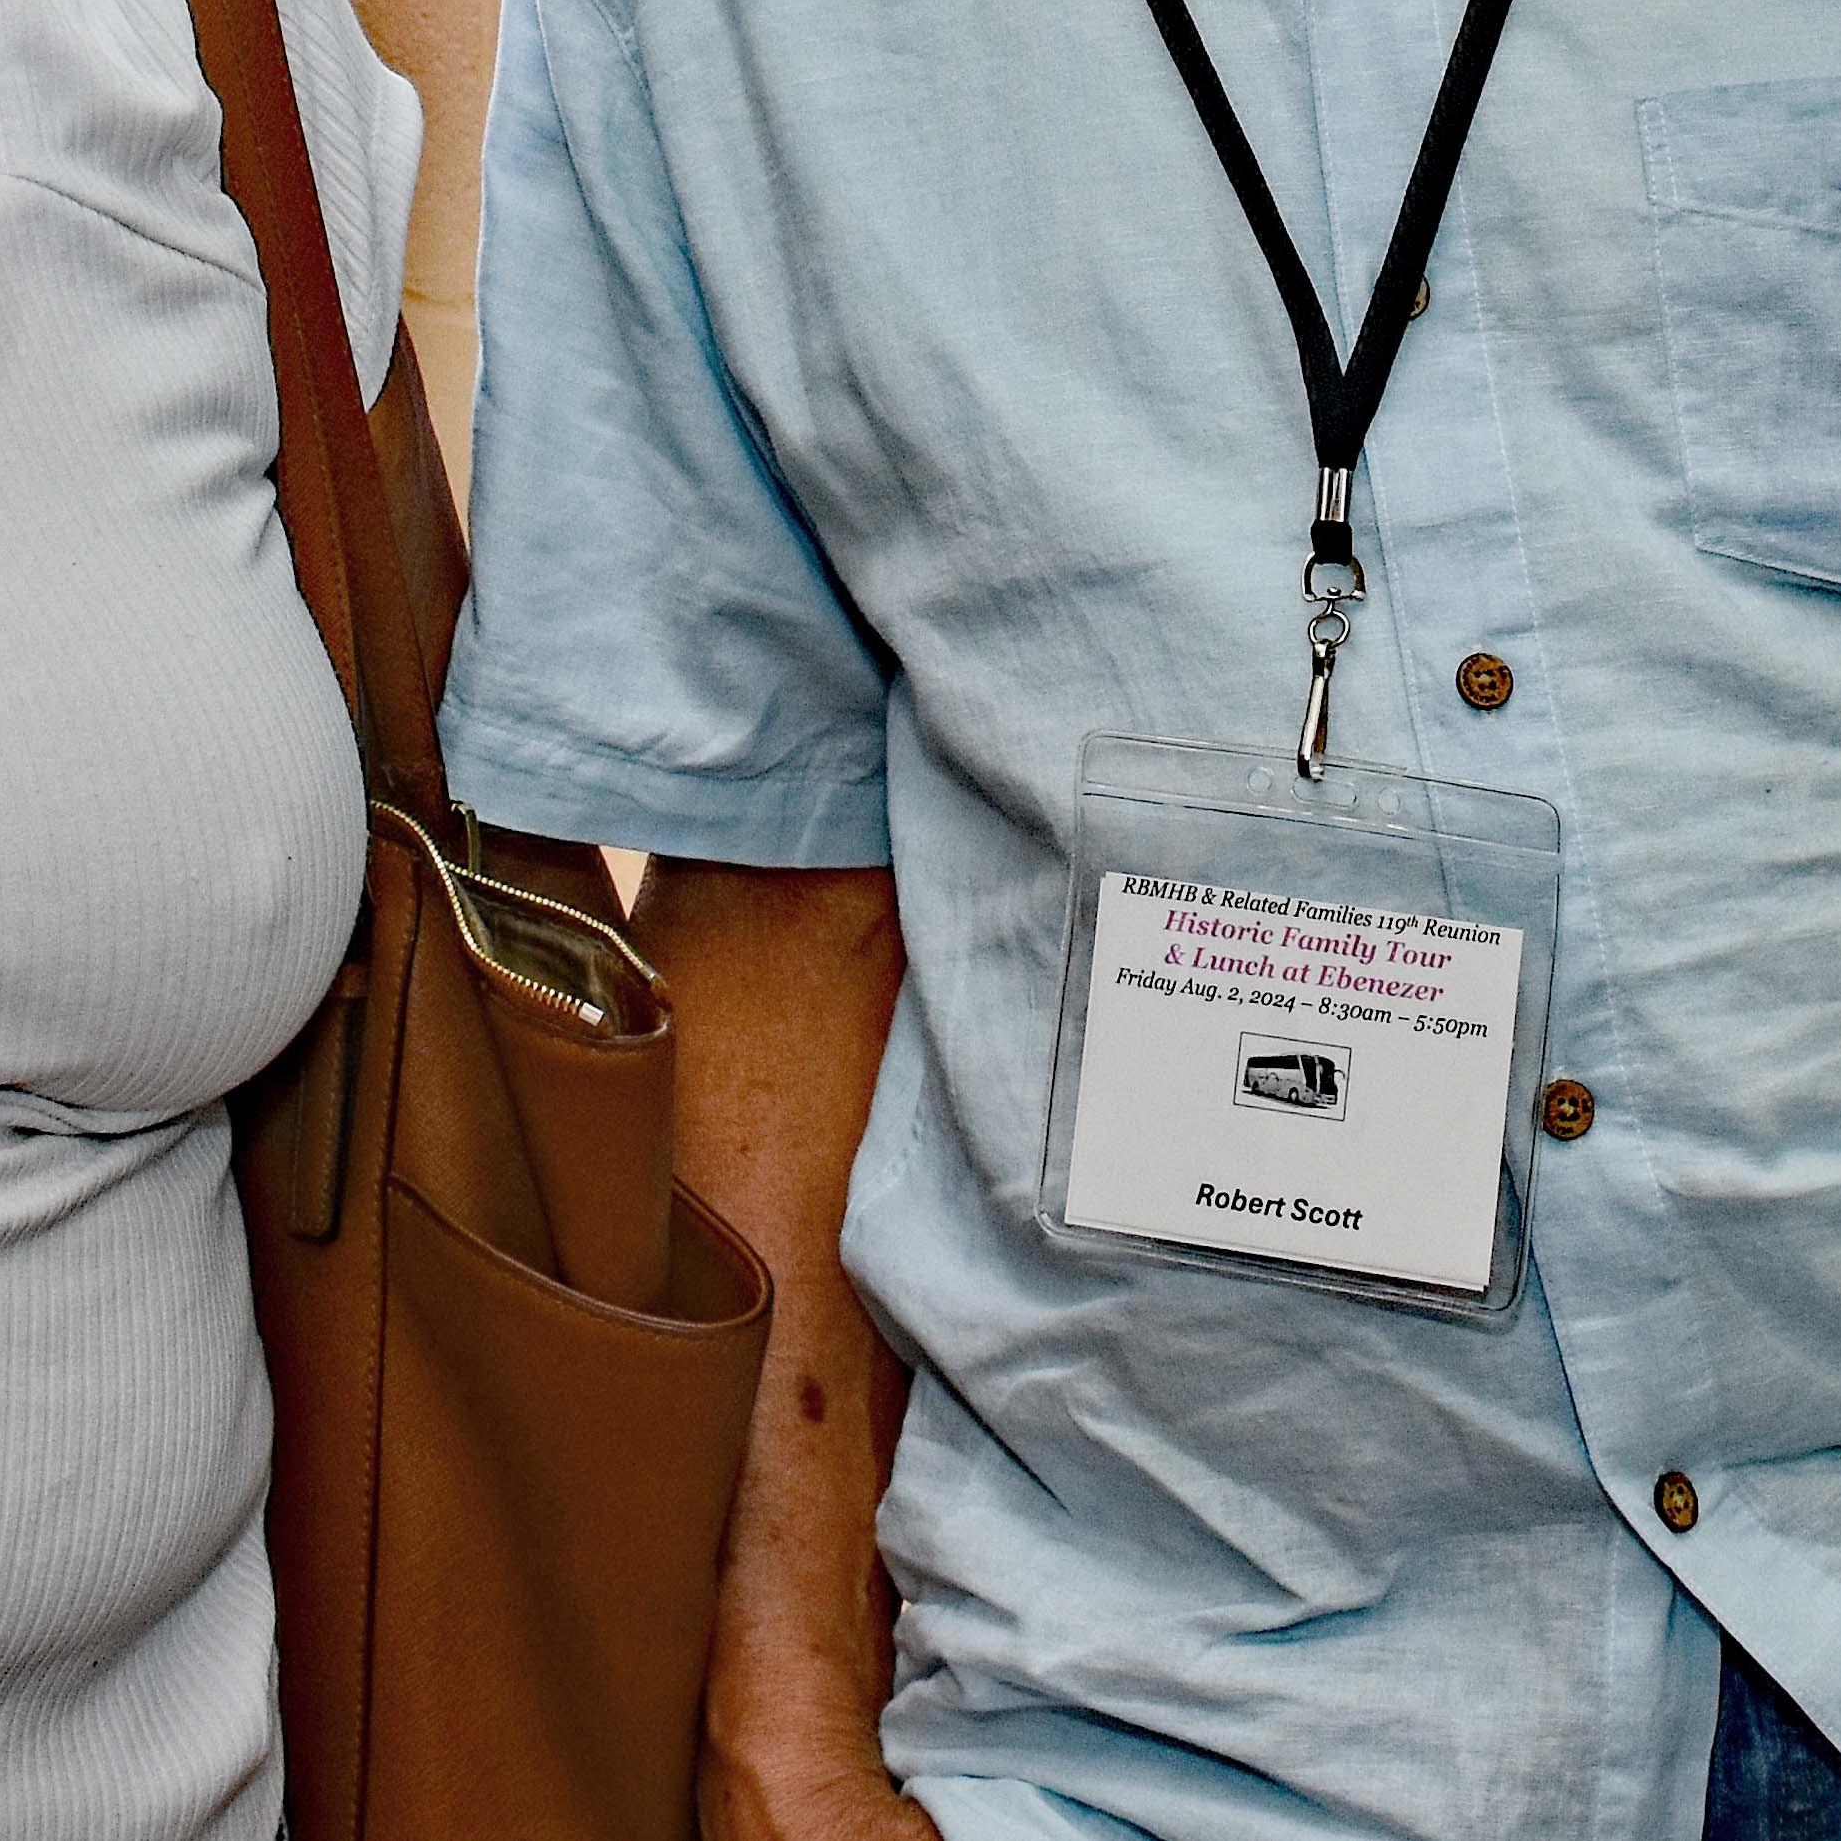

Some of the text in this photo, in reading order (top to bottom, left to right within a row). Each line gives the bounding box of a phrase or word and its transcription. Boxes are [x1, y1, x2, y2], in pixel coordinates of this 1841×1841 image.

[1121, 875, 1501, 947] RBMHB & Related Families 119th Reunion
[1164, 909, 1453, 971] Historic Family Tour
[1115, 967, 1178, 996] Friday
[1180, 979, 1223, 1002] Aug.
[1227, 987, 1245, 1007] 2,
[1249, 990, 1296, 1013] 2024
[1317, 997, 1392, 1026] 8:30am
[1413, 1014, 1489, 1039] 5:50pm
[1163, 943, 1445, 1004] & Lunch at Ebenezer
[1195, 1182, 1363, 1231] Robert Scott
